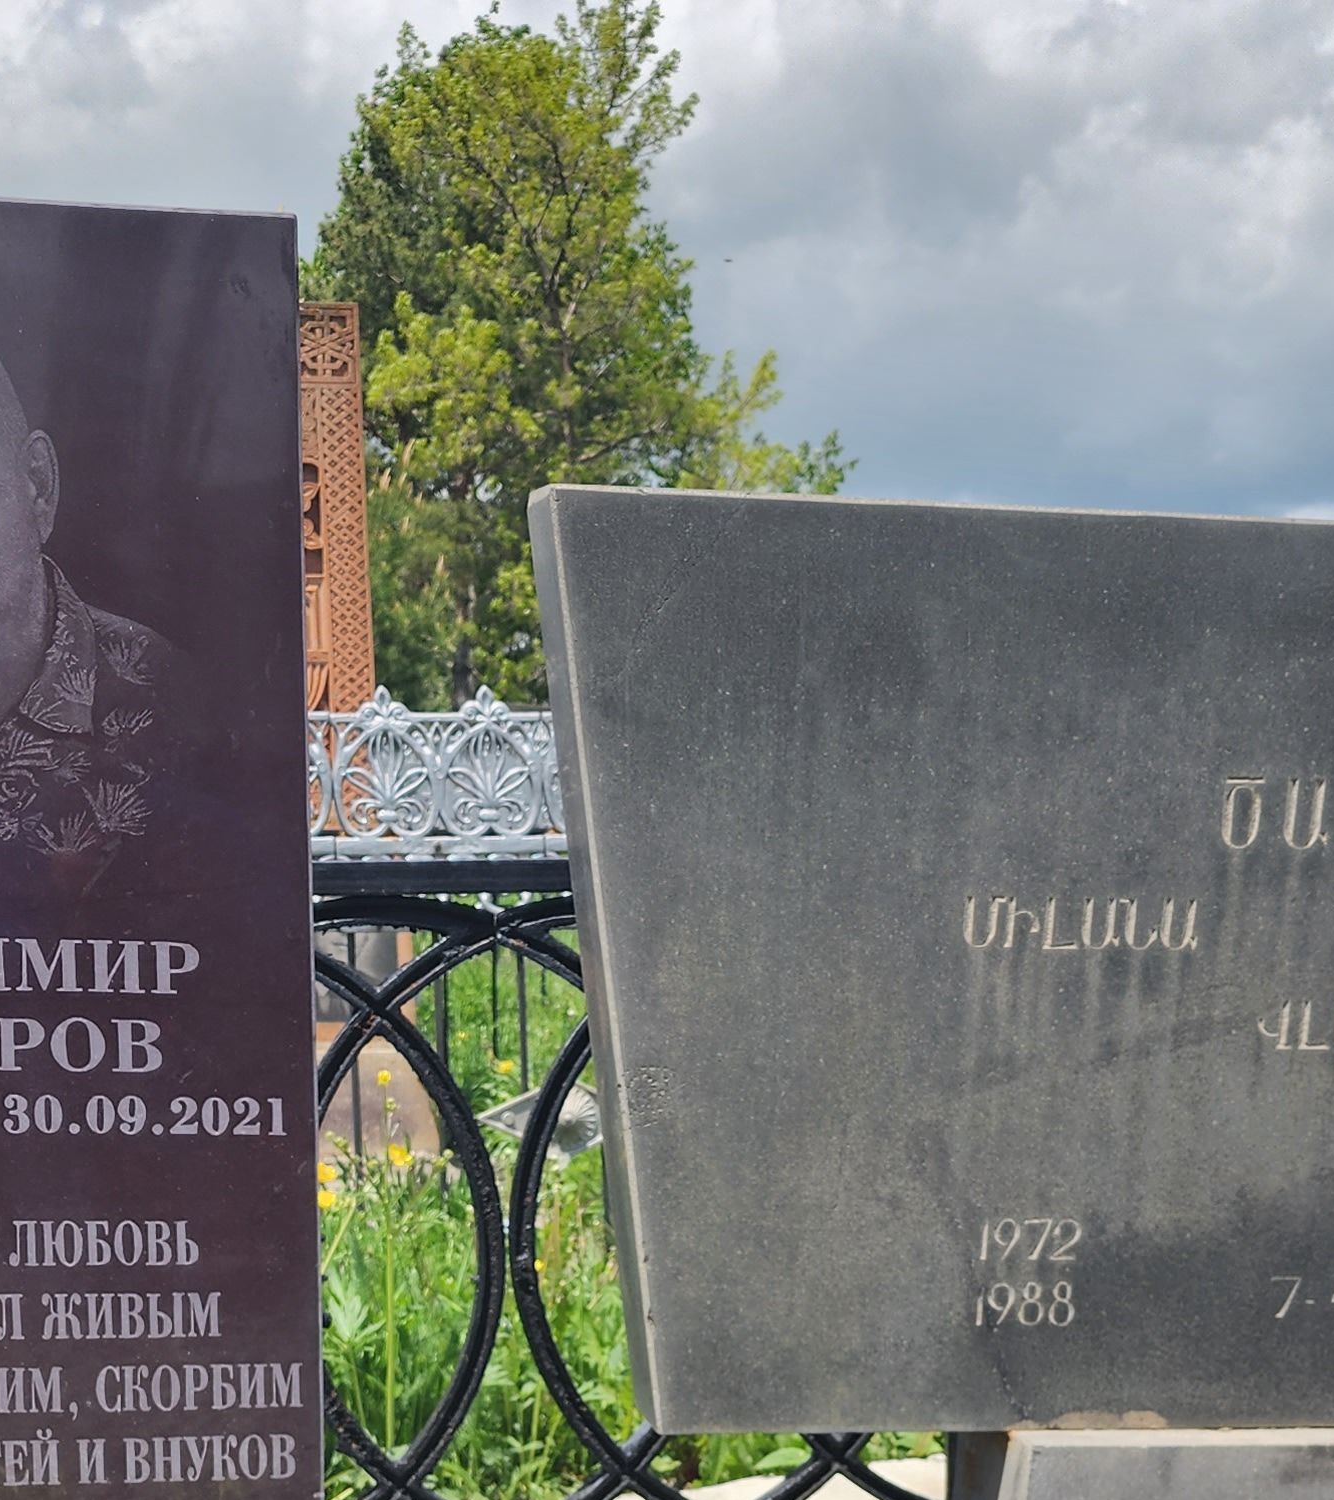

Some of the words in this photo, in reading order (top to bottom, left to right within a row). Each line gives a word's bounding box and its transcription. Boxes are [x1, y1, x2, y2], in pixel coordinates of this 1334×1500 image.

[962, 896, 1199, 951] ՄԻԼԱՆԱ
[3, 1093, 288, 1137] 30.09.2021
[8, 1219, 200, 1268] ЛЮБОВЬ
[979, 1218, 1082, 1261] 1972
[41, 1291, 222, 1341] ЖИВЫМ
[975, 1280, 1076, 1327] 1988
[95, 1362, 304, 1414] СКОРБИМ
[76, 1438, 109, 1485] И
[122, 1433, 296, 1484] ВНУКОВ
